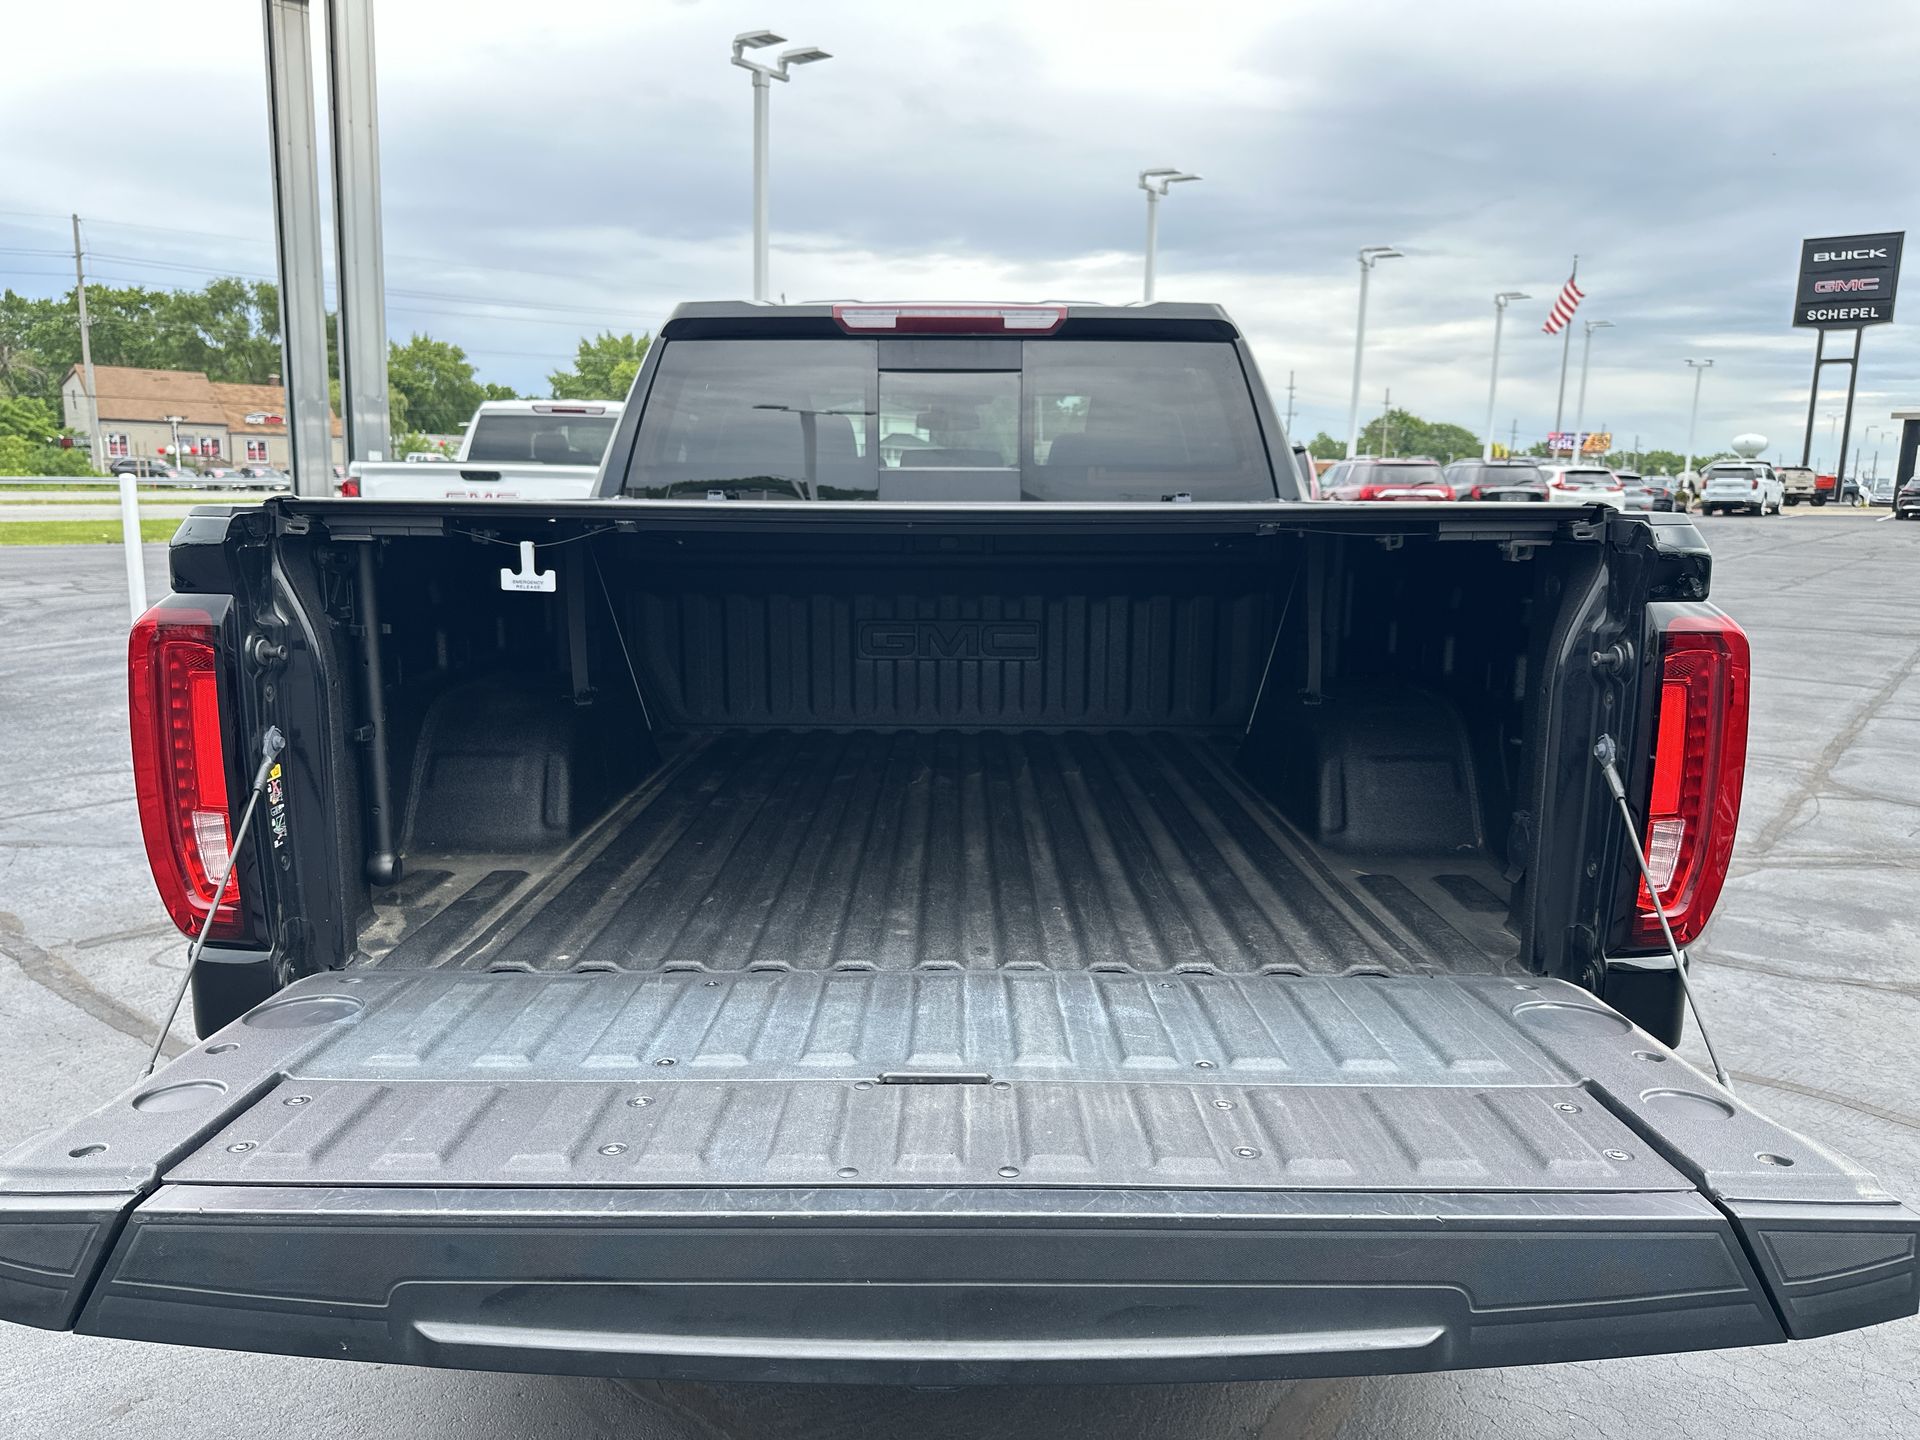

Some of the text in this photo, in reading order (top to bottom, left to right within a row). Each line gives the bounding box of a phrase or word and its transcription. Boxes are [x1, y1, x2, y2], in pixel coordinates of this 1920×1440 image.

[1813, 248, 1888, 262] BUICK
[1814, 277, 1880, 294] GMC
[1806, 307, 1879, 321] SCHEPEL
[859, 622, 1039, 658] GMC
